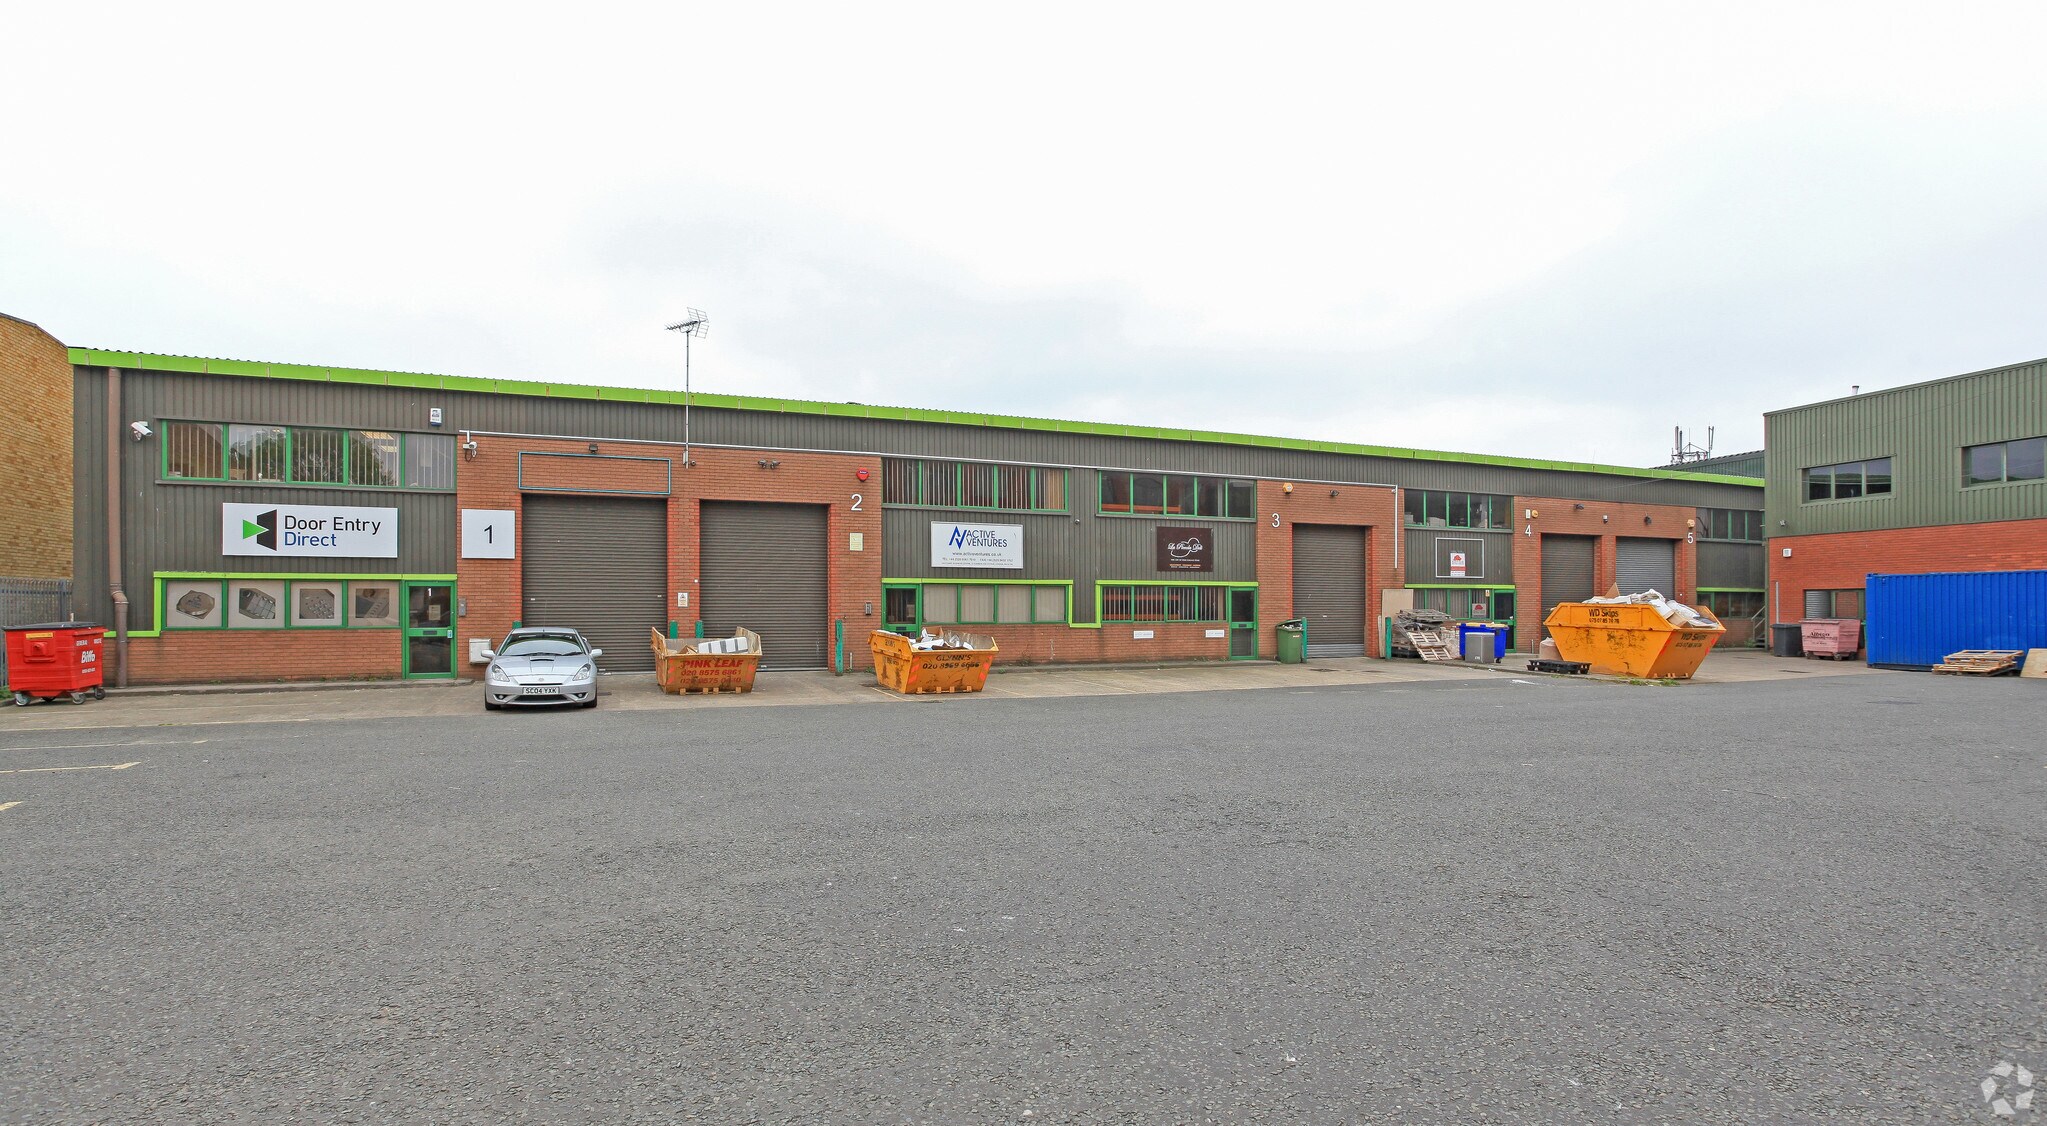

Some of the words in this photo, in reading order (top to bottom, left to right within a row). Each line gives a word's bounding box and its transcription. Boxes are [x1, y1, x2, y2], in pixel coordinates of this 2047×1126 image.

[851, 494, 862, 510] 2
[284, 515, 327, 531] Door
[333, 516, 381, 535] Entry
[1272, 513, 1280, 527] 3
[484, 525, 492, 543] 1
[966, 530, 995, 538] ACTIVE
[1525, 524, 1531, 537] 4
[284, 531, 337, 547] Direct
[966, 538, 1007, 547] VENTURES
[1687, 532, 1693, 544] 5
[1588, 608, 1600, 617] WD
[1601, 608, 1619, 618] Skips
[680, 659, 712, 668] PINK
[714, 659, 744, 668] LEAF
